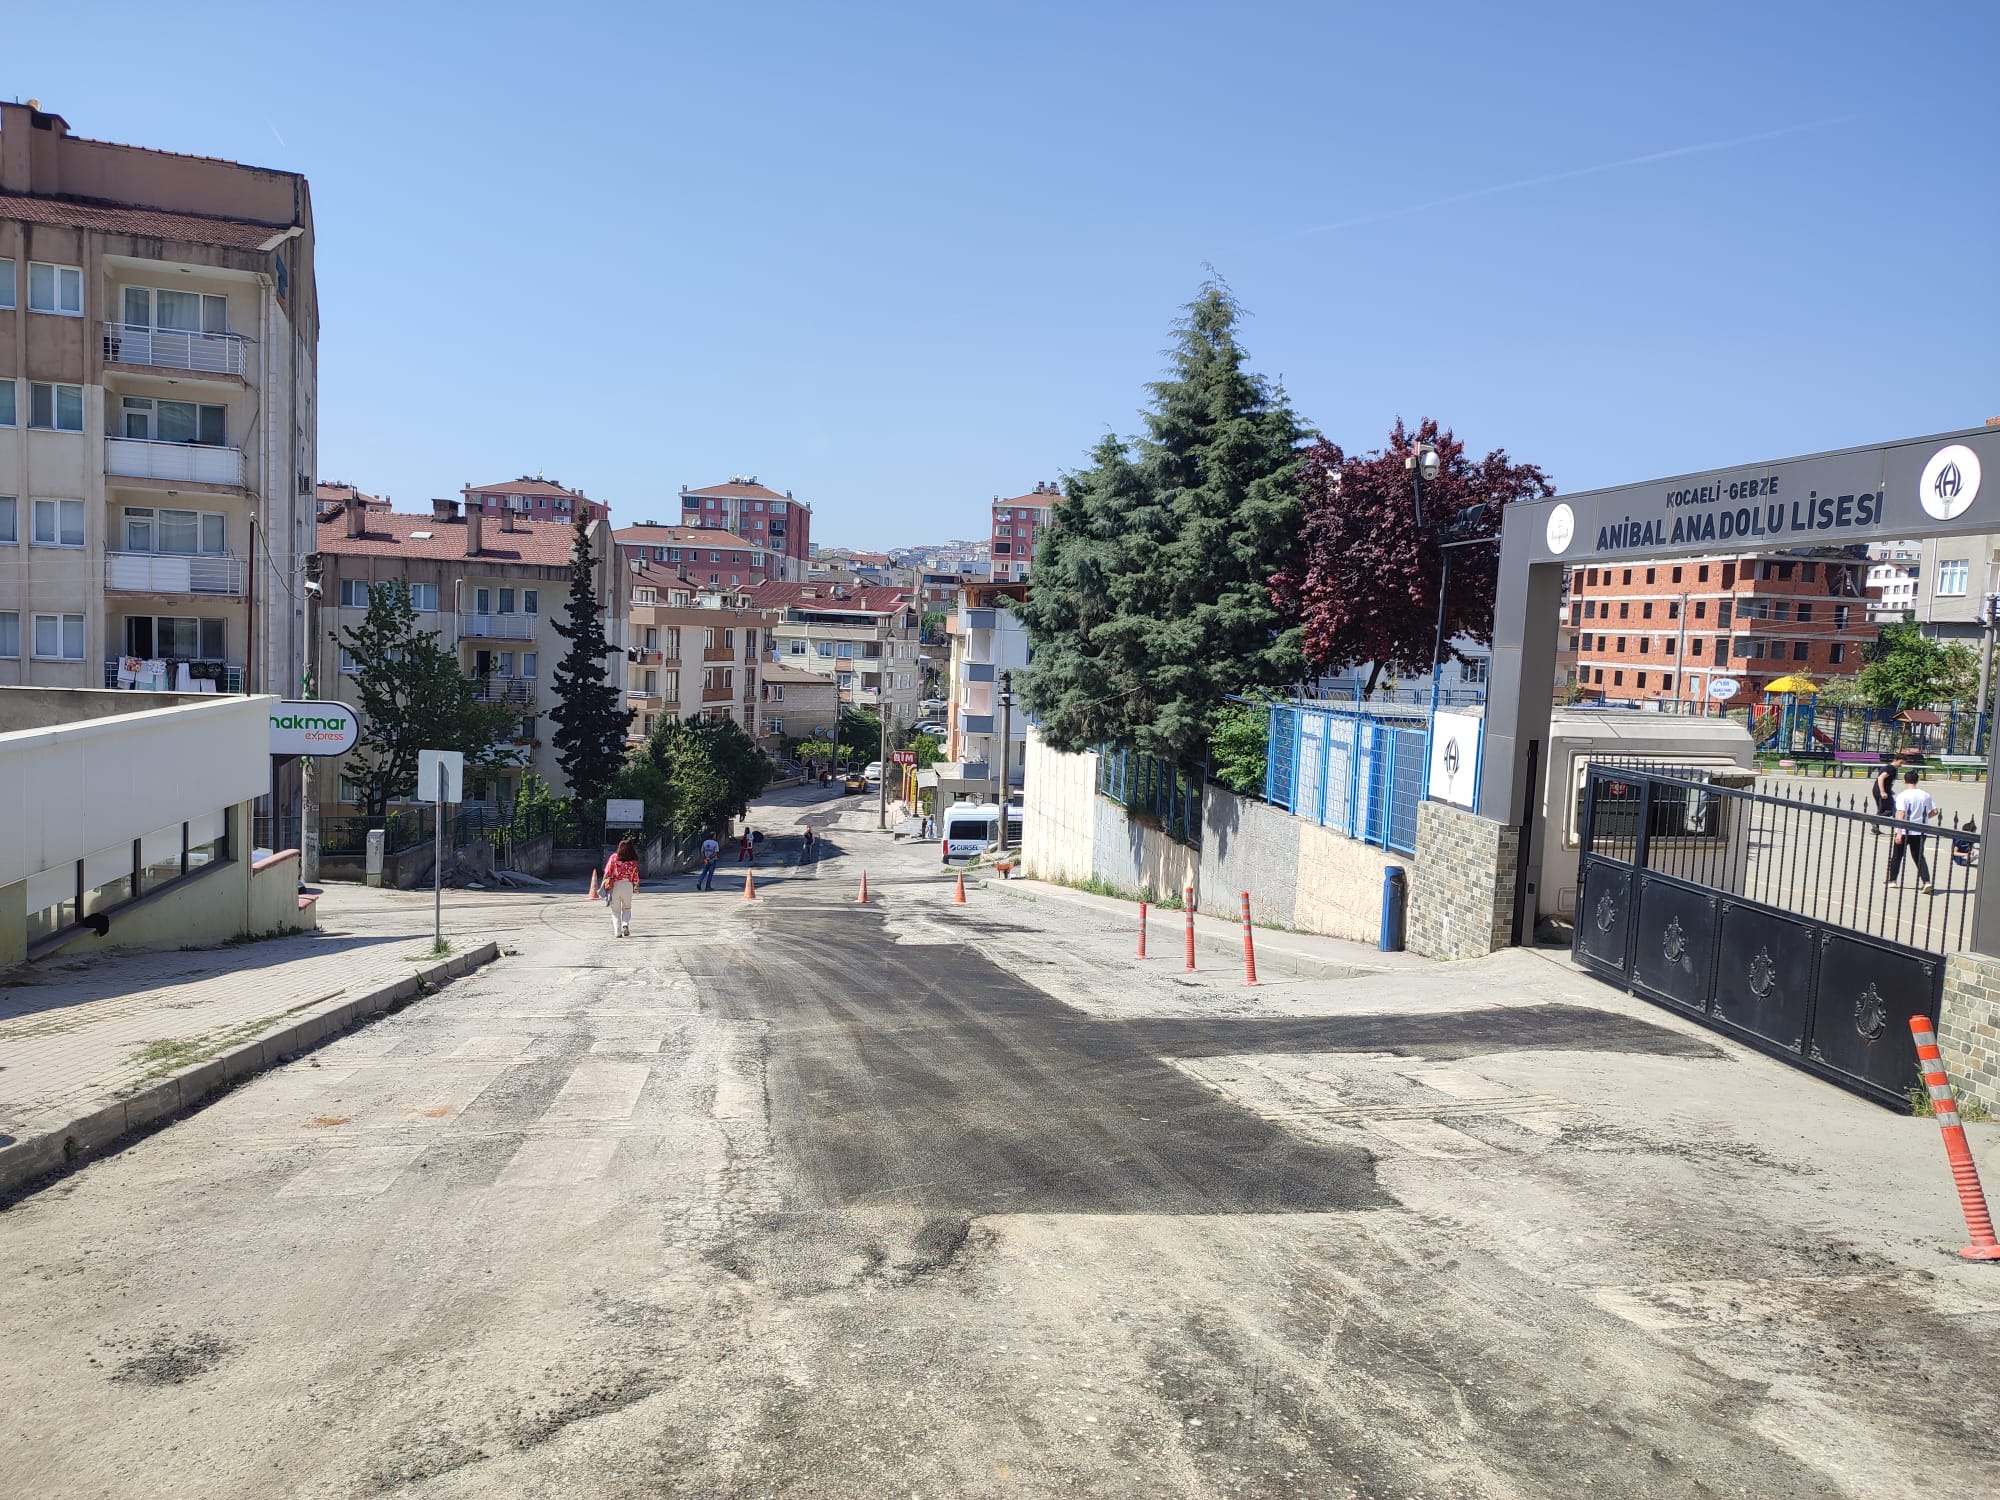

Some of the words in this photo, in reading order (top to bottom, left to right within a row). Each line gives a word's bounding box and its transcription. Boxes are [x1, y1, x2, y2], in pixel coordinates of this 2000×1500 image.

[1596, 516, 1666, 551] ANİBAL
[1670, 503, 1785, 544] ANADOLU
[305, 731, 344, 741] express
